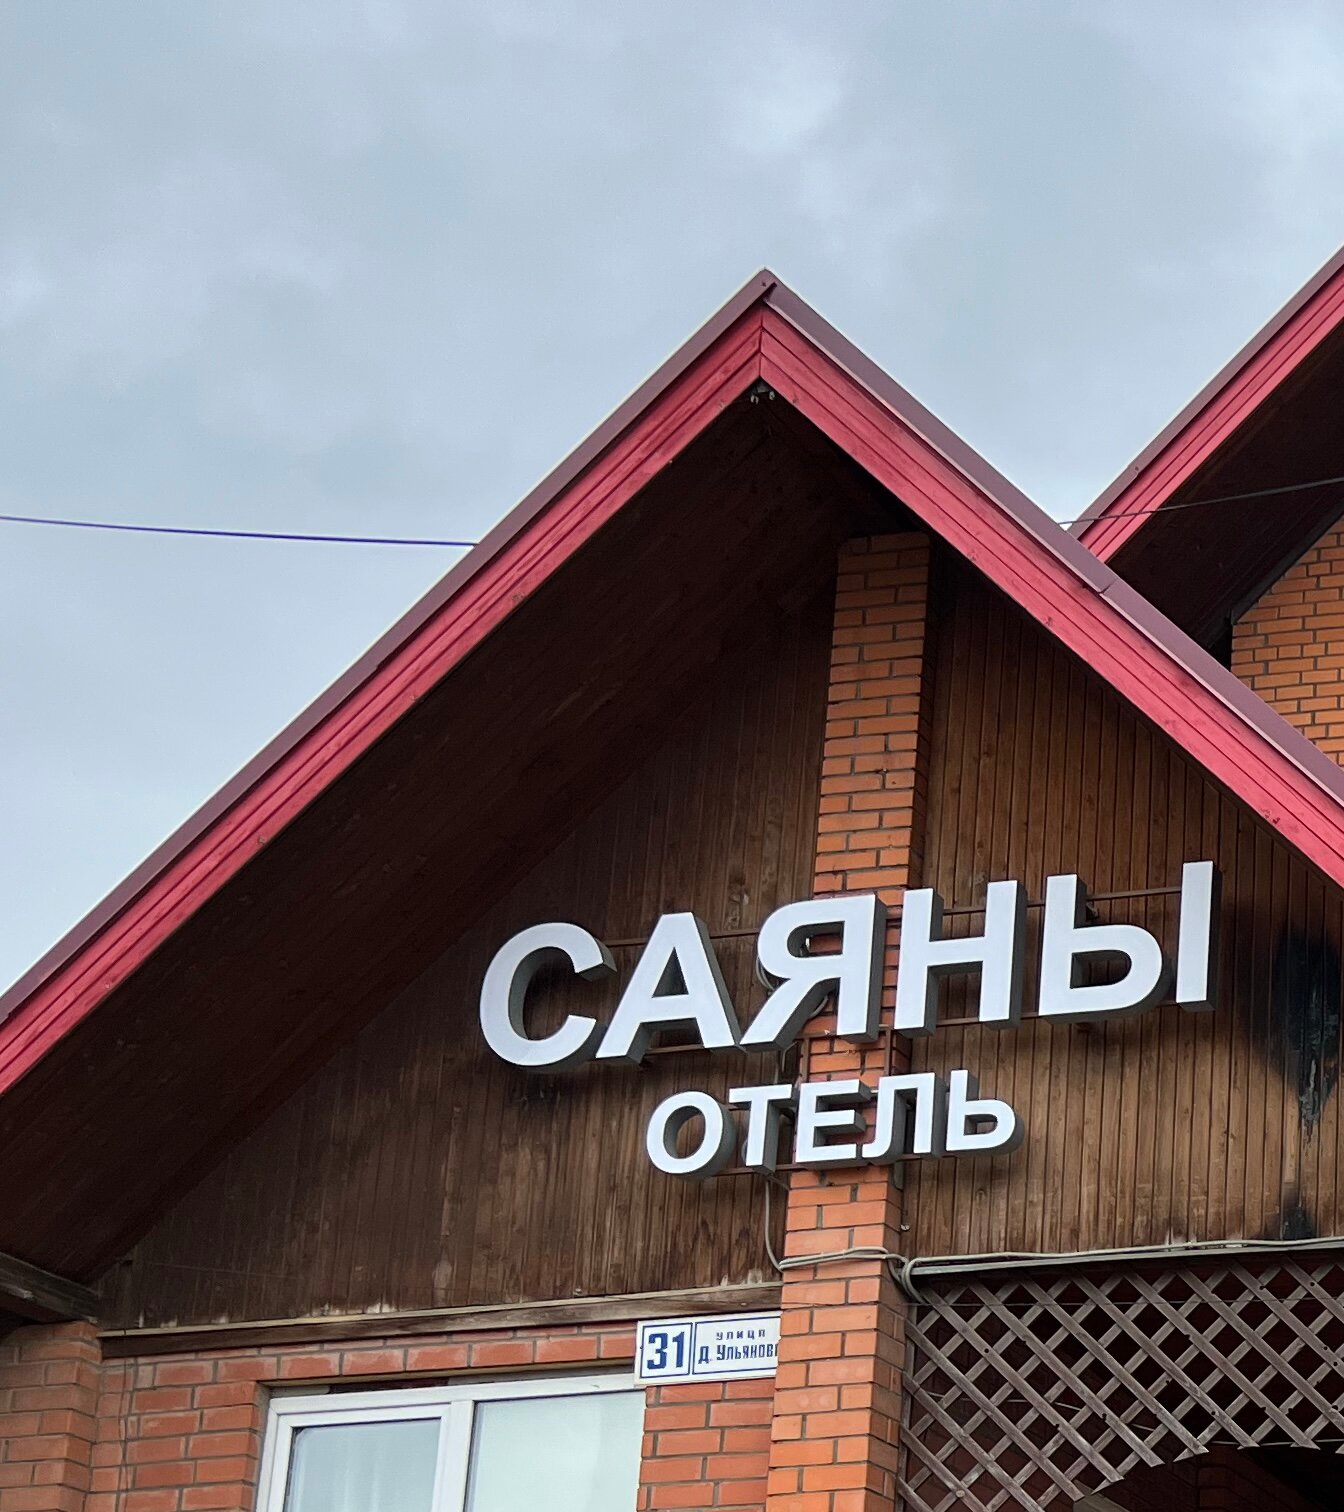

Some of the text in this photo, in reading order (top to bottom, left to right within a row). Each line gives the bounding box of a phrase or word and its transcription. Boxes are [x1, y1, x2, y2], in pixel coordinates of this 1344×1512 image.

[478, 860, 1214, 1066] САЯНЫ
[646, 1069, 1016, 1174] ОТЕЛЬ
[646, 1331, 685, 1370] 31
